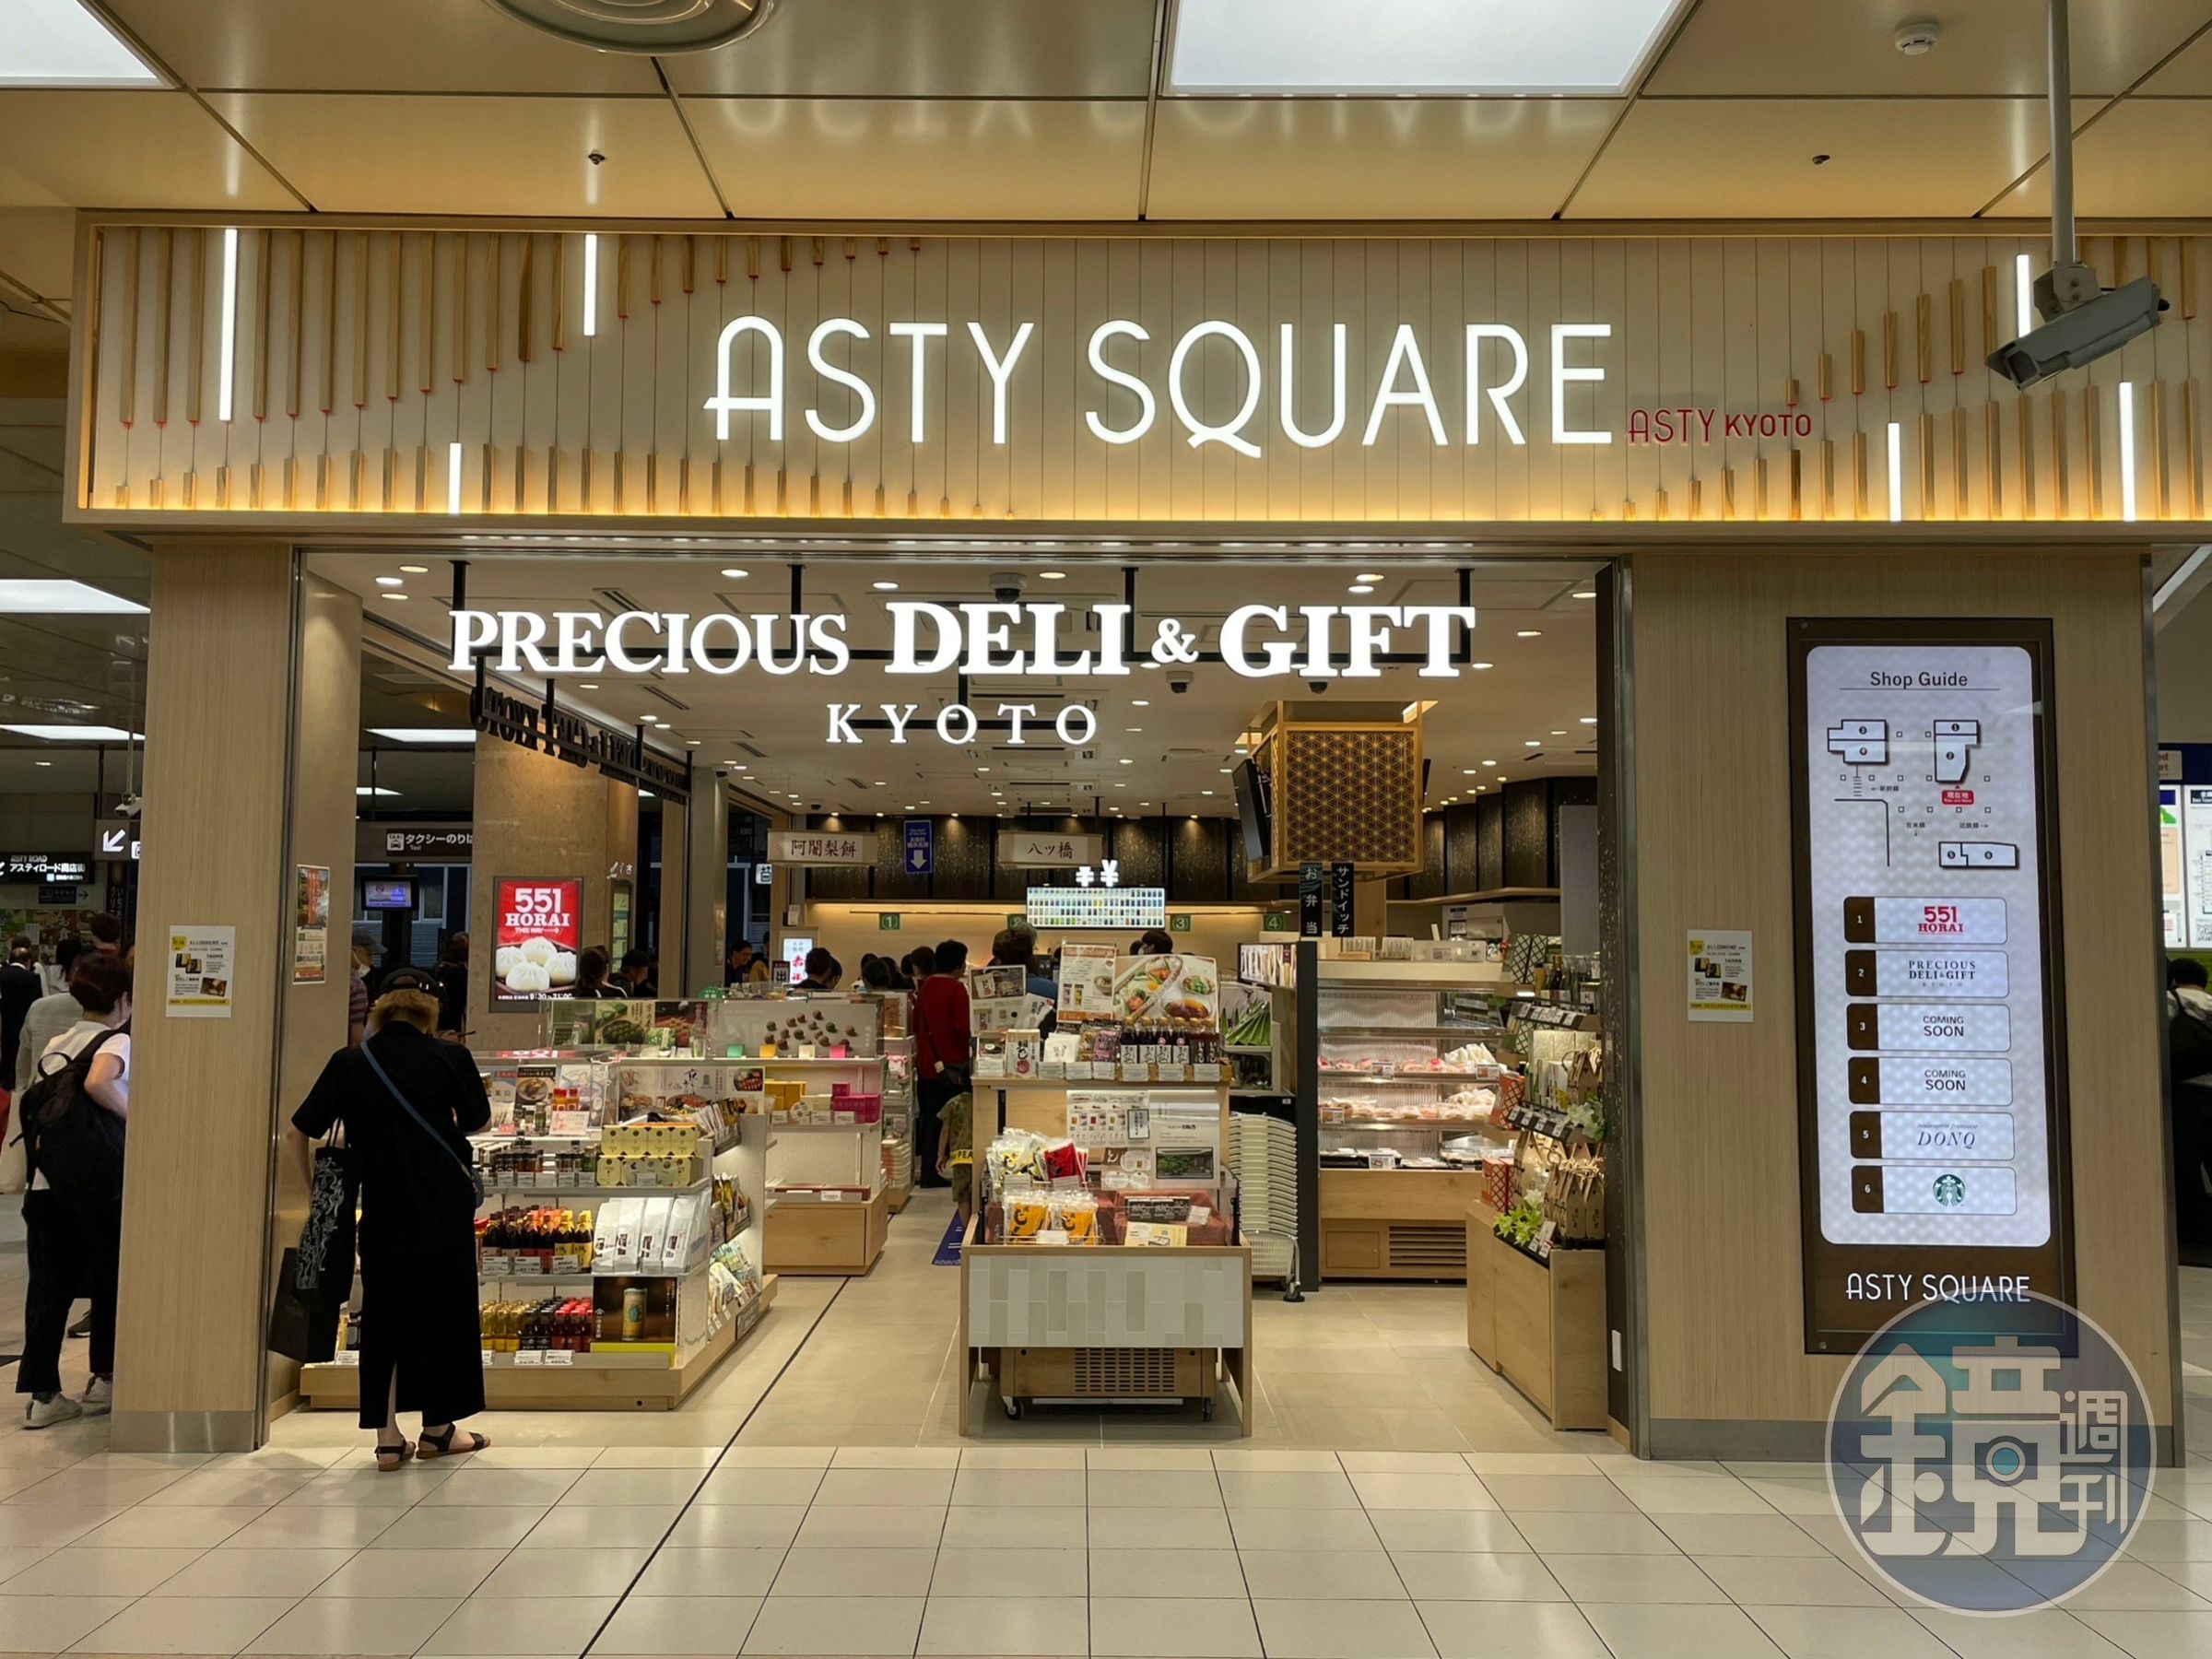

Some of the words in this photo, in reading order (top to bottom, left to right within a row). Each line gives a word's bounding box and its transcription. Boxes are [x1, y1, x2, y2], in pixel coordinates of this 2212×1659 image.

[702, 315, 1034, 444] ASTY
[1085, 320, 1613, 458] SQUARE
[1627, 408, 1716, 445] ASTY
[1724, 412, 1812, 439] KYOTO
[447, 609, 851, 676] PRECIOUS
[884, 602, 1131, 676] DELI
[1150, 617, 1199, 664] &
[1219, 604, 1476, 678] GIFT
[1870, 672, 1912, 689] Shop
[1918, 672, 1968, 686] Guide
[826, 703, 1097, 746] KYOTO
[1028, 841, 1074, 860] 八ツ橋
[514, 888, 561, 913] 551
[1305, 866, 1318, 934] お弁当
[1336, 866, 1349, 935] サンドイッチ
[505, 912, 571, 927] HORAI
[1857, 915, 1863, 924] 1
[1924, 906, 1957, 923] 551
[1918, 924, 1963, 932] HORAI
[1909, 960, 1976, 969] PRECIOUS
[1858, 969, 1865, 977] 2
[1860, 1022, 1865, 1030] 3
[1923, 1016, 1964, 1024] COMING
[1924, 1026, 1964, 1037] SOON
[1862, 1076, 1867, 1084] 4
[1924, 1069, 1966, 1078] COMING
[1925, 1079, 1966, 1090] SOON
[1863, 1130, 1869, 1139] 5
[1917, 1131, 1976, 1149] DONQ
[1865, 1184, 1871, 1193] 6
[1845, 1273, 1912, 1301] ASTY
[1922, 1274, 2031, 1304] SQUARE
